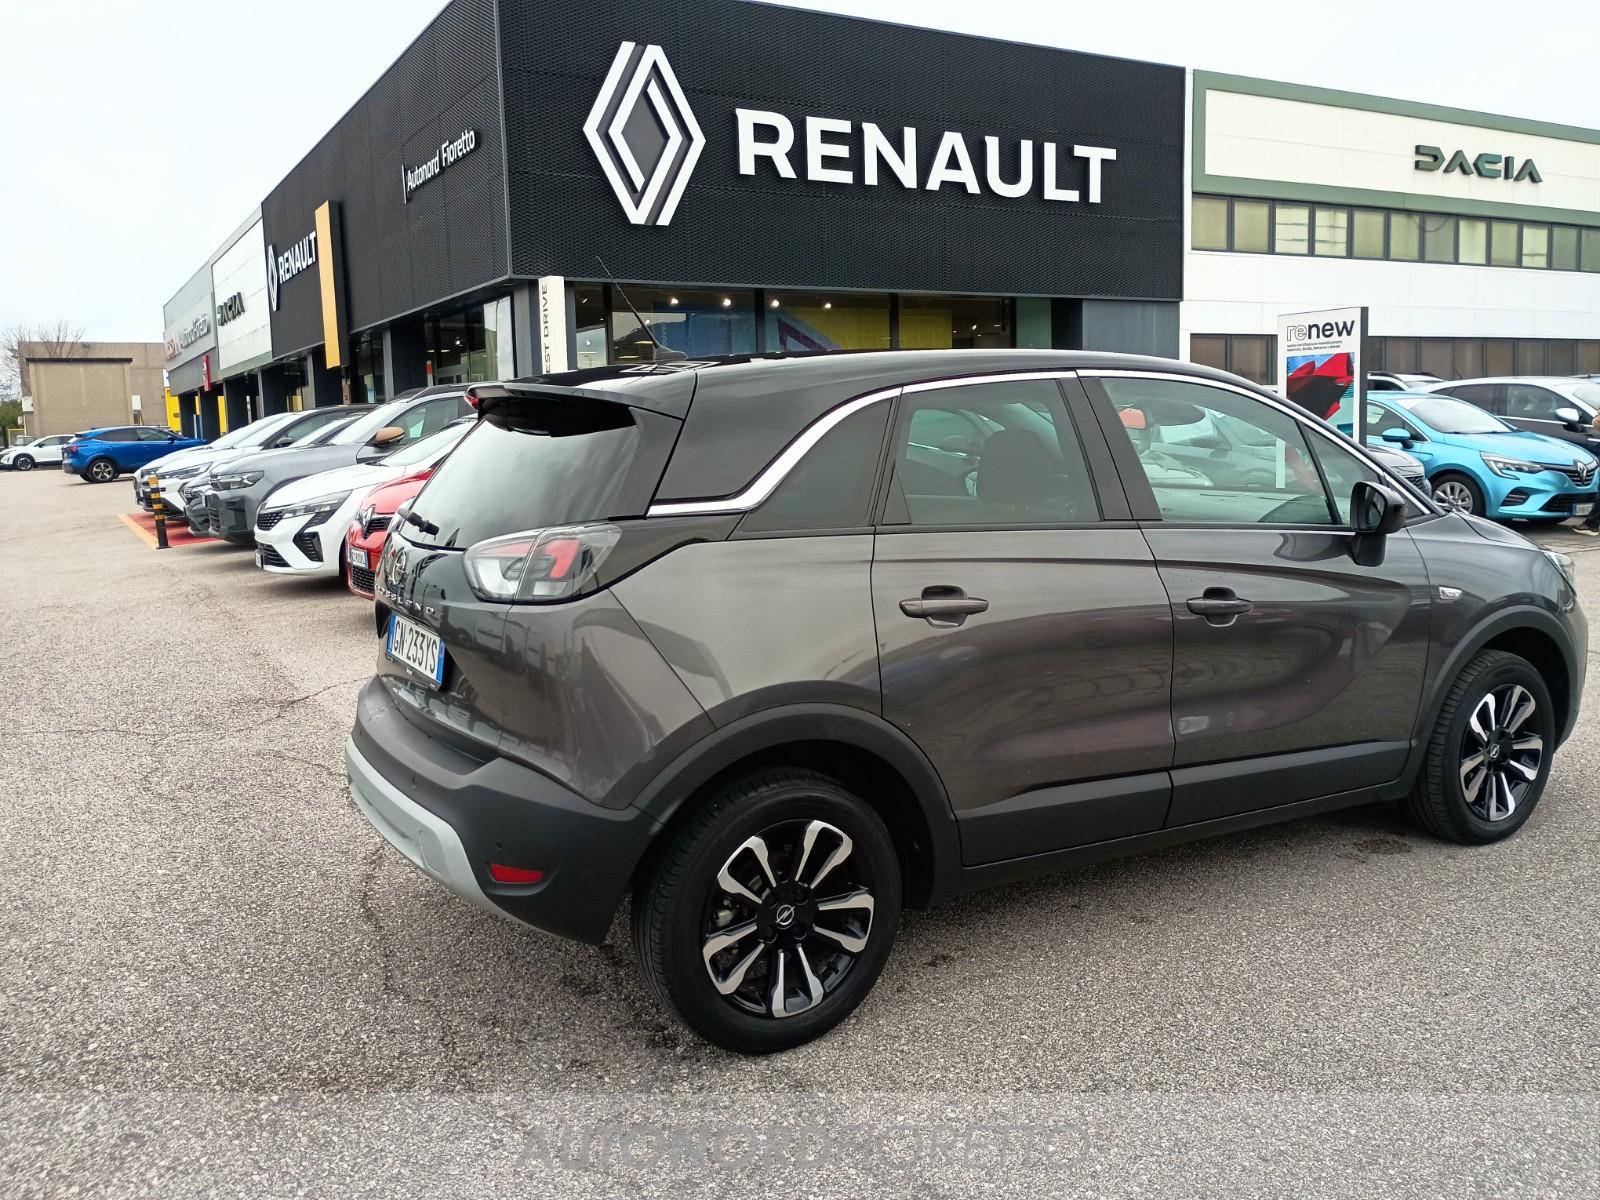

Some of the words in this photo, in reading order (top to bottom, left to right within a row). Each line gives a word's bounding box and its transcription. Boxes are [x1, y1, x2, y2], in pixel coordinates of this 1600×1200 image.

[407, 149, 440, 192] Autonord
[441, 129, 476, 168] Fioretto
[735, 107, 1117, 204] RENAULT
[1414, 144, 1543, 184] DACIA
[277, 231, 316, 284] RENAULT
[541, 284, 549, 338] DRIVE
[1286, 320, 1356, 342] renew
